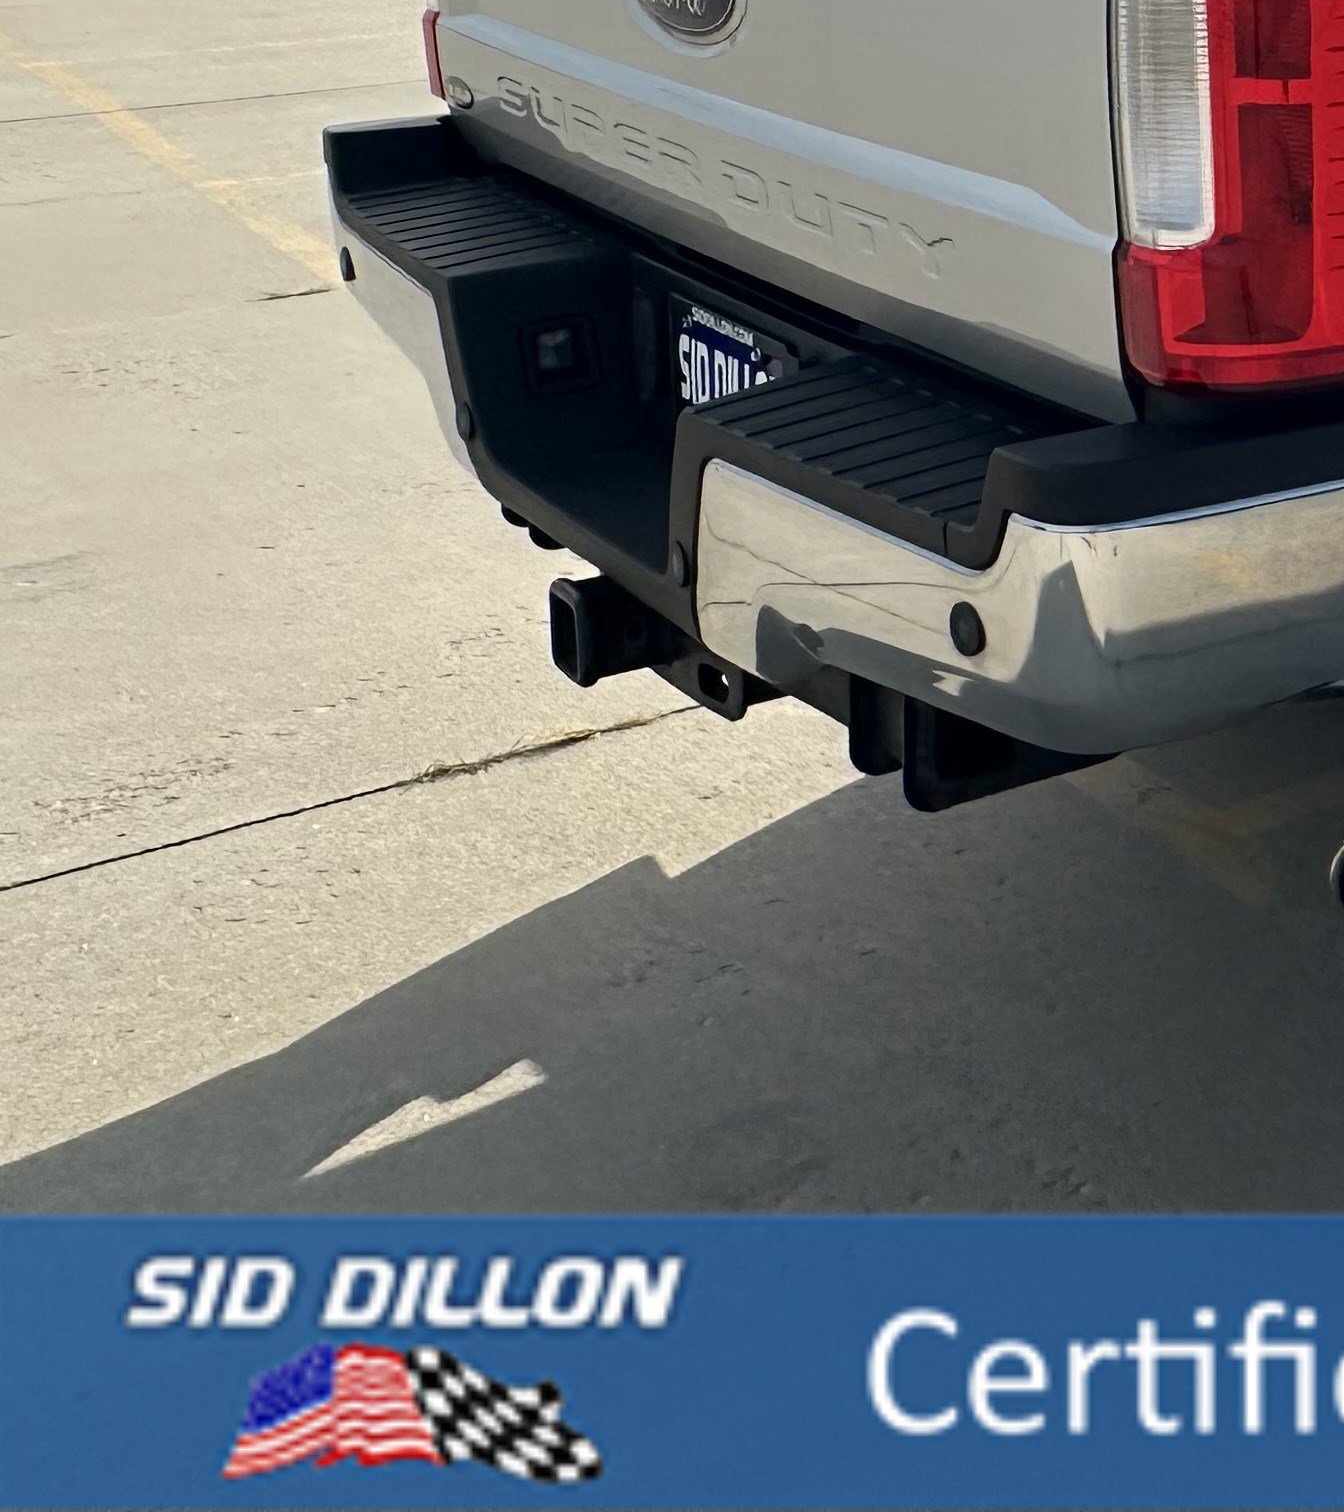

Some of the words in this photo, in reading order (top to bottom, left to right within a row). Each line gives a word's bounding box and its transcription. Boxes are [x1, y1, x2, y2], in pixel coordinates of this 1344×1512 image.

[497, 75, 702, 186] SUPER
[719, 158, 956, 279] DUTY
[679, 333, 710, 404] SID
